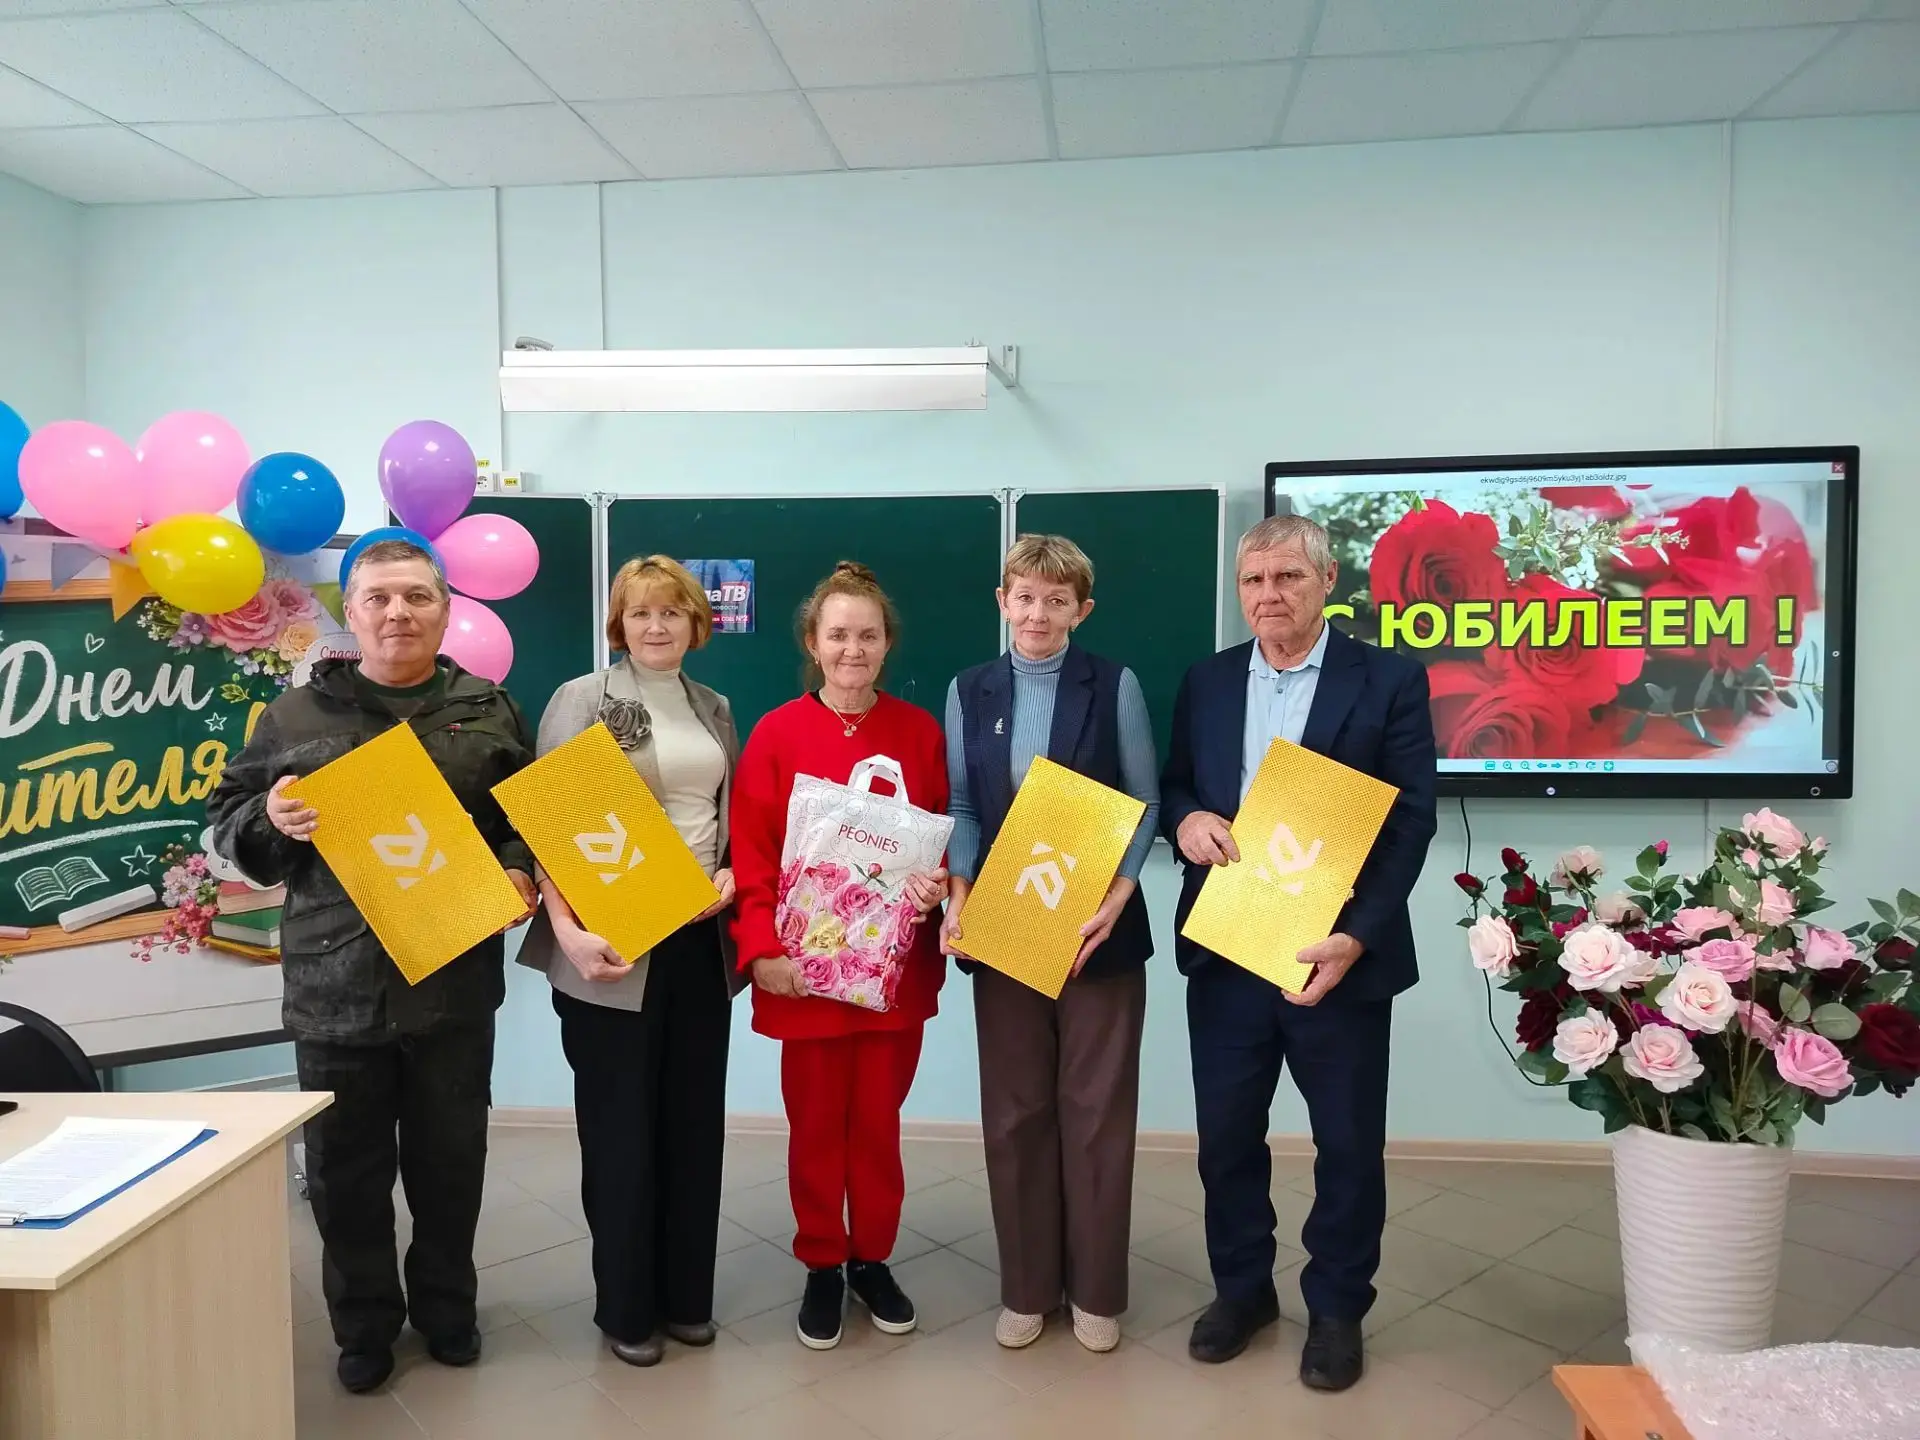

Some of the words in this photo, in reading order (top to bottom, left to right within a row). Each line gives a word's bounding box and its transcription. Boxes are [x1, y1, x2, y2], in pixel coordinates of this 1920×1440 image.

[1380, 599, 1746, 648] ЮБИЛЕЕМ
[1777, 599, 1794, 643] !
[0, 640, 214, 738] Днем
[838, 824, 900, 854] PEONIES
